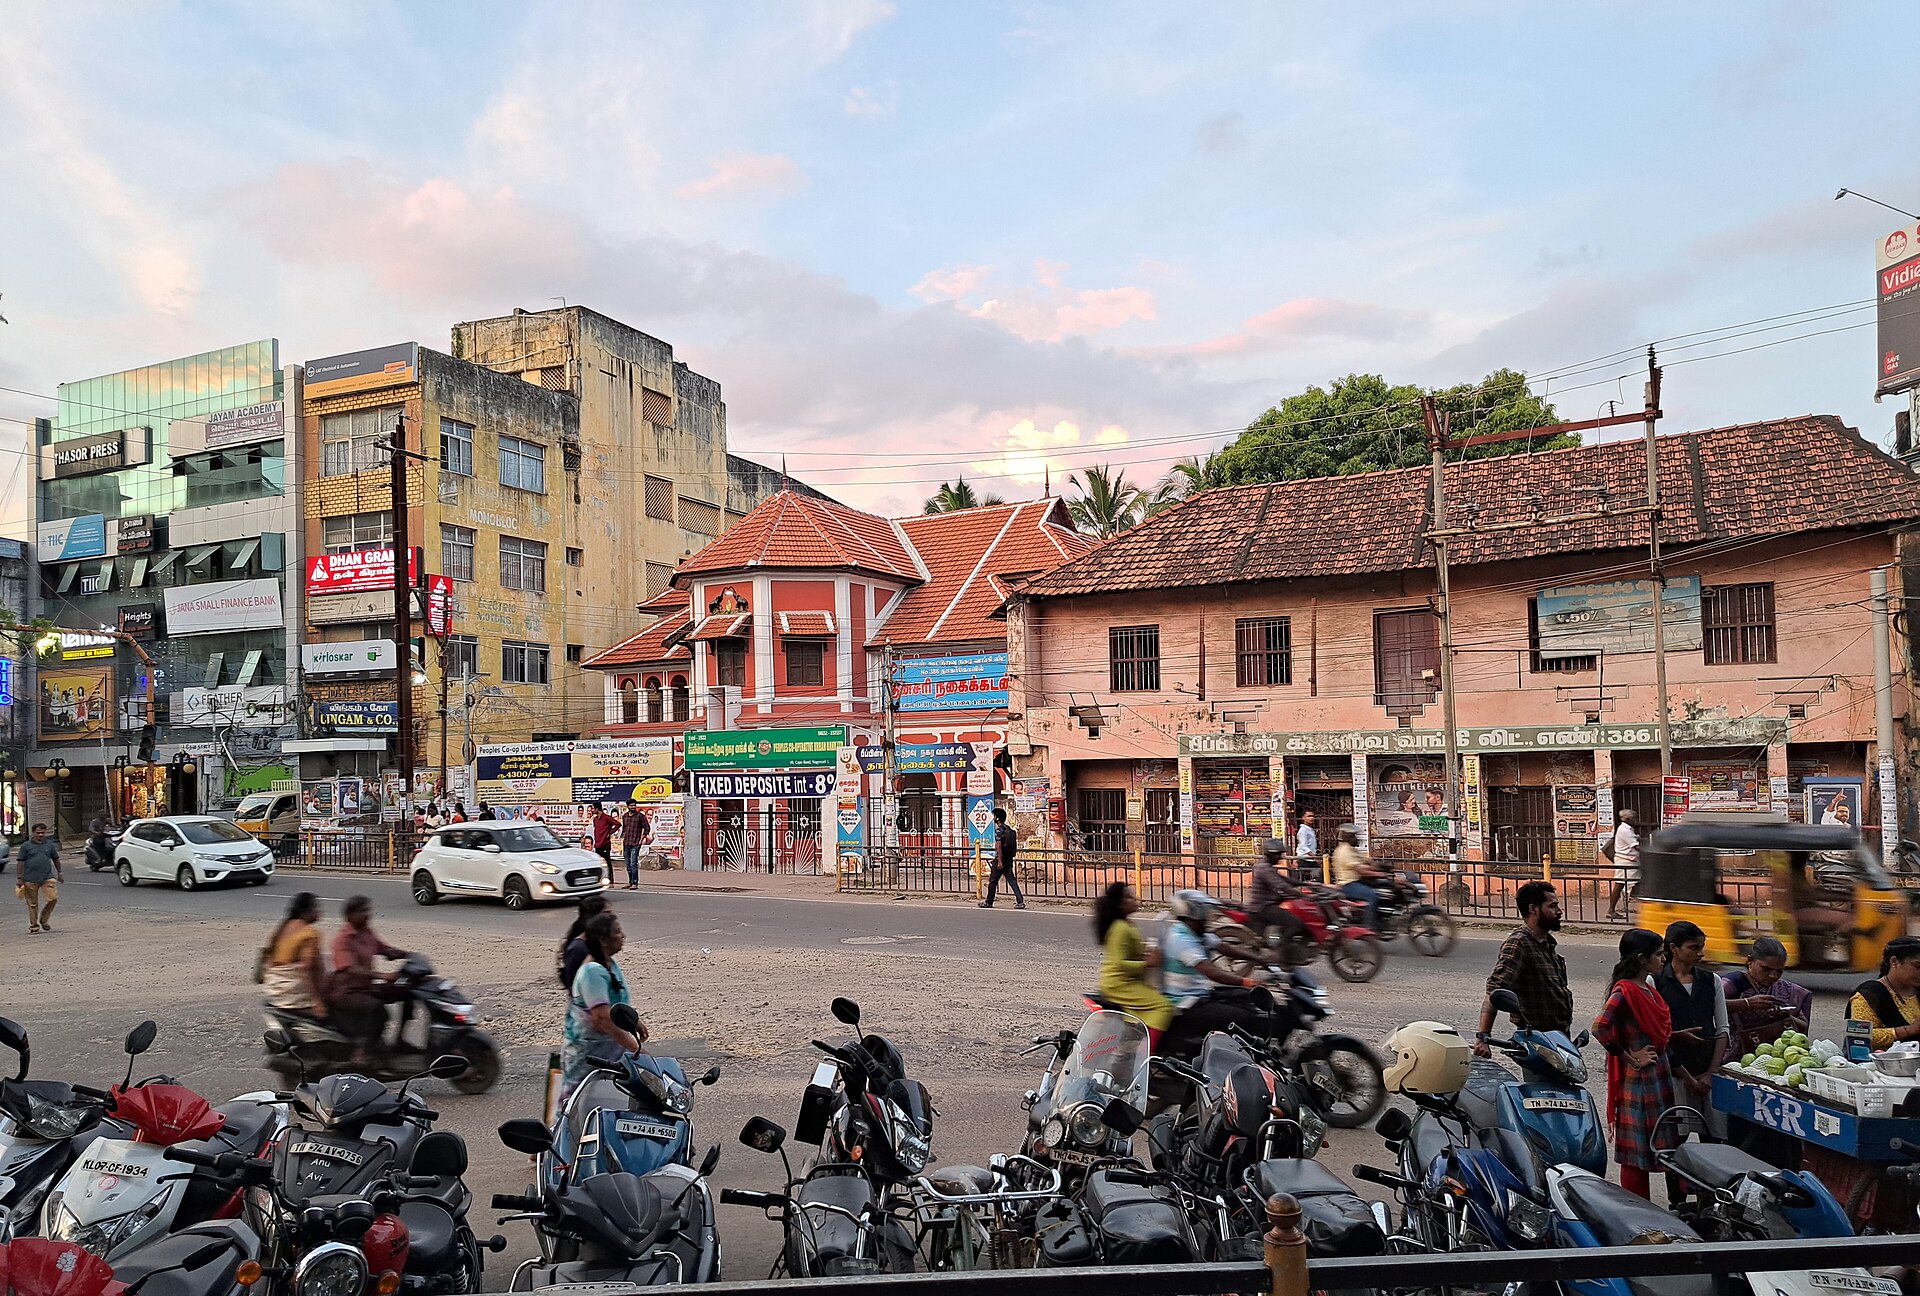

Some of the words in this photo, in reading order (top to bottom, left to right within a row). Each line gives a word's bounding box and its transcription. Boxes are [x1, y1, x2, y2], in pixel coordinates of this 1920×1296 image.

[1887, 354, 1900, 364] SAVE
[1886, 362, 1898, 370] GAS
[208, 410, 235, 423] JAYAM
[237, 402, 277, 418] ACADEMY
[55, 447, 88, 466] THASOR
[90, 441, 119, 457] PRESS
[469, 509, 518, 529] MONOBLOC
[48, 533, 64, 547] TIIC
[329, 553, 362, 568] DHAN
[177, 601, 196, 613] JANA
[196, 600, 220, 611] SMALL
[220, 597, 253, 609] FINANCE
[254, 595, 276, 607] BANK
[124, 611, 152, 623] Heights
[201, 692, 243, 706] FEATHER
[366, 717, 374, 725] &
[501, 746, 519, 754] Co-op
[521, 744, 539, 752] Urban
[920, 747, 935, 758] நகர
[935, 747, 955, 755] வங்கி
[955, 746, 968, 755] லிட்
[938, 758, 967, 769] கடன்
[609, 766, 632, 775] 8%
[699, 776, 732, 795] FIXED
[734, 776, 791, 795] DEPOSITE
[794, 776, 807, 794] int
[1373, 783, 1406, 793] DIWALI
[975, 812, 988, 822] 20
[622, 1123, 630, 1131] TN
[310, 1158, 331, 1168] Anu
[305, 1171, 325, 1182] Avi
[1811, 1274, 1831, 1286] TN
[1874, 1281, 1898, 1293] 1986
